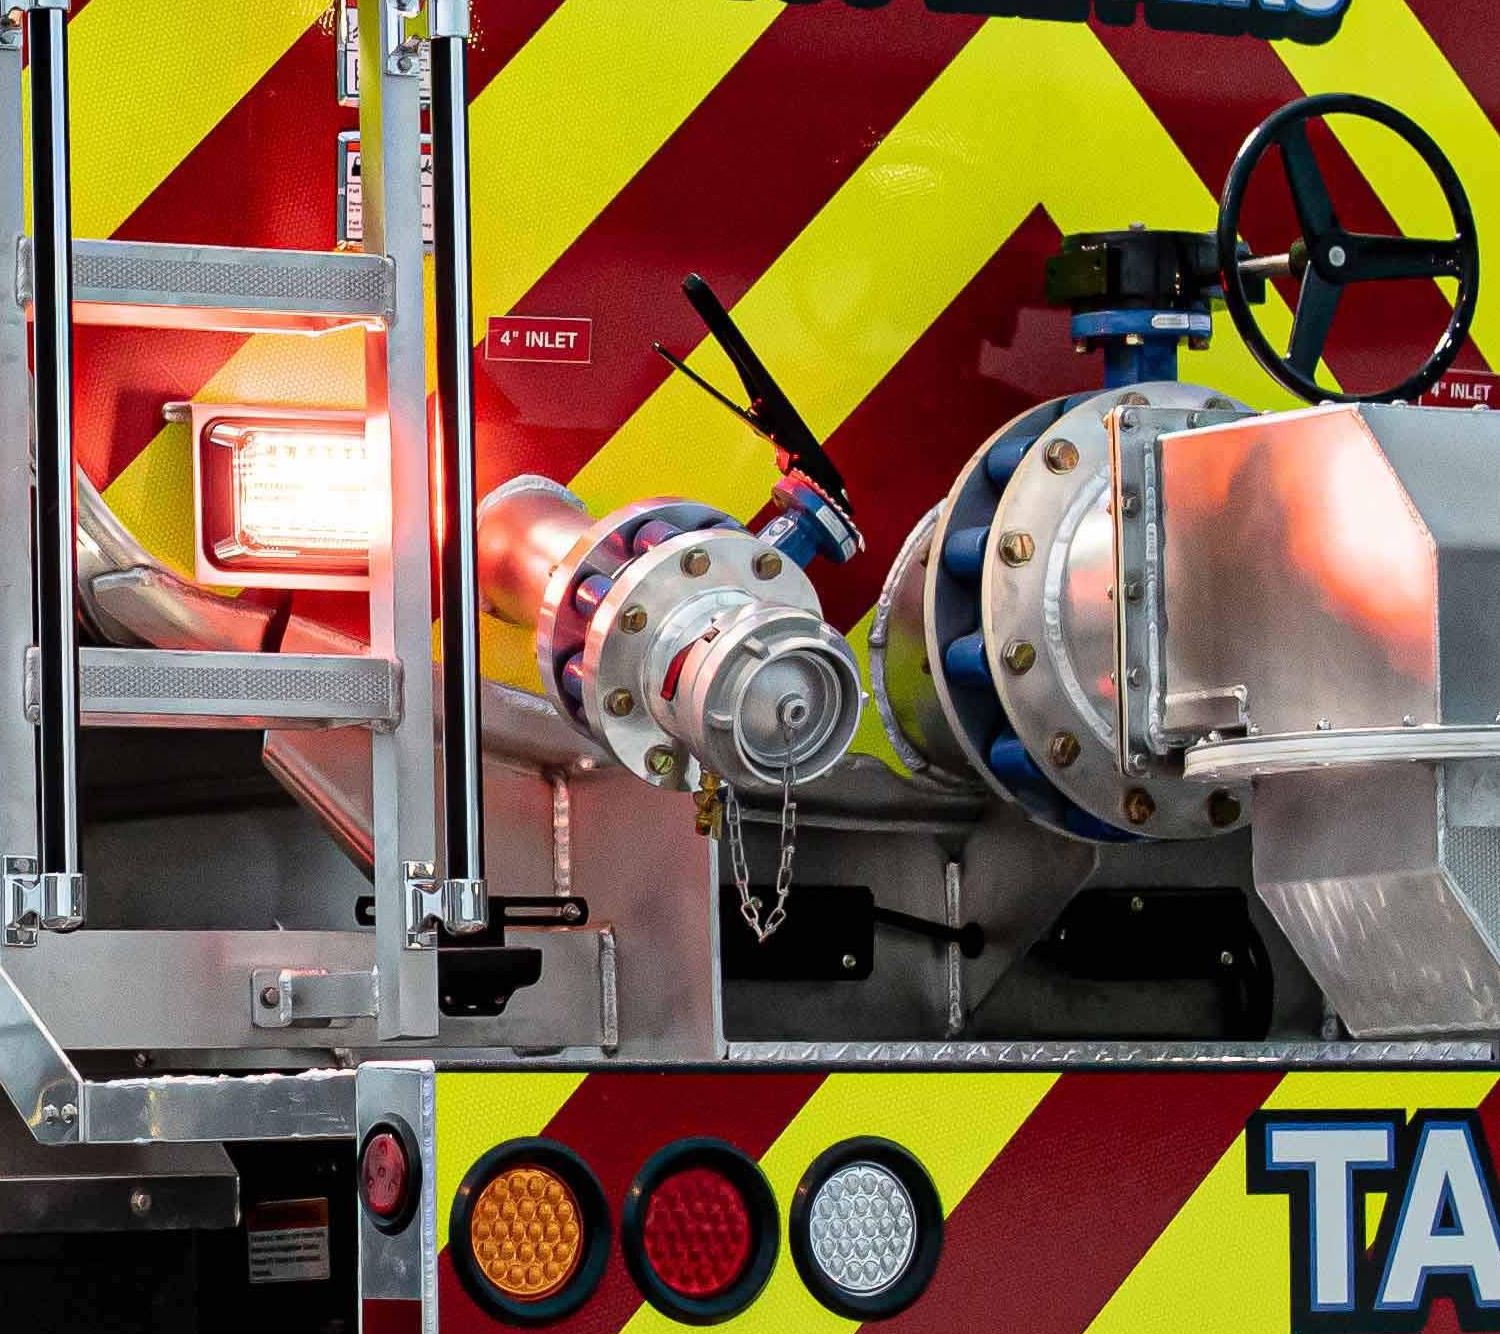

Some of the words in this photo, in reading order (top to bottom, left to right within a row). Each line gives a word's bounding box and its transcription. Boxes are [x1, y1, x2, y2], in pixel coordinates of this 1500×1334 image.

[500, 330, 519, 346] 4"
[525, 330, 578, 348] INLET
[1450, 382, 1492, 401] INLET
